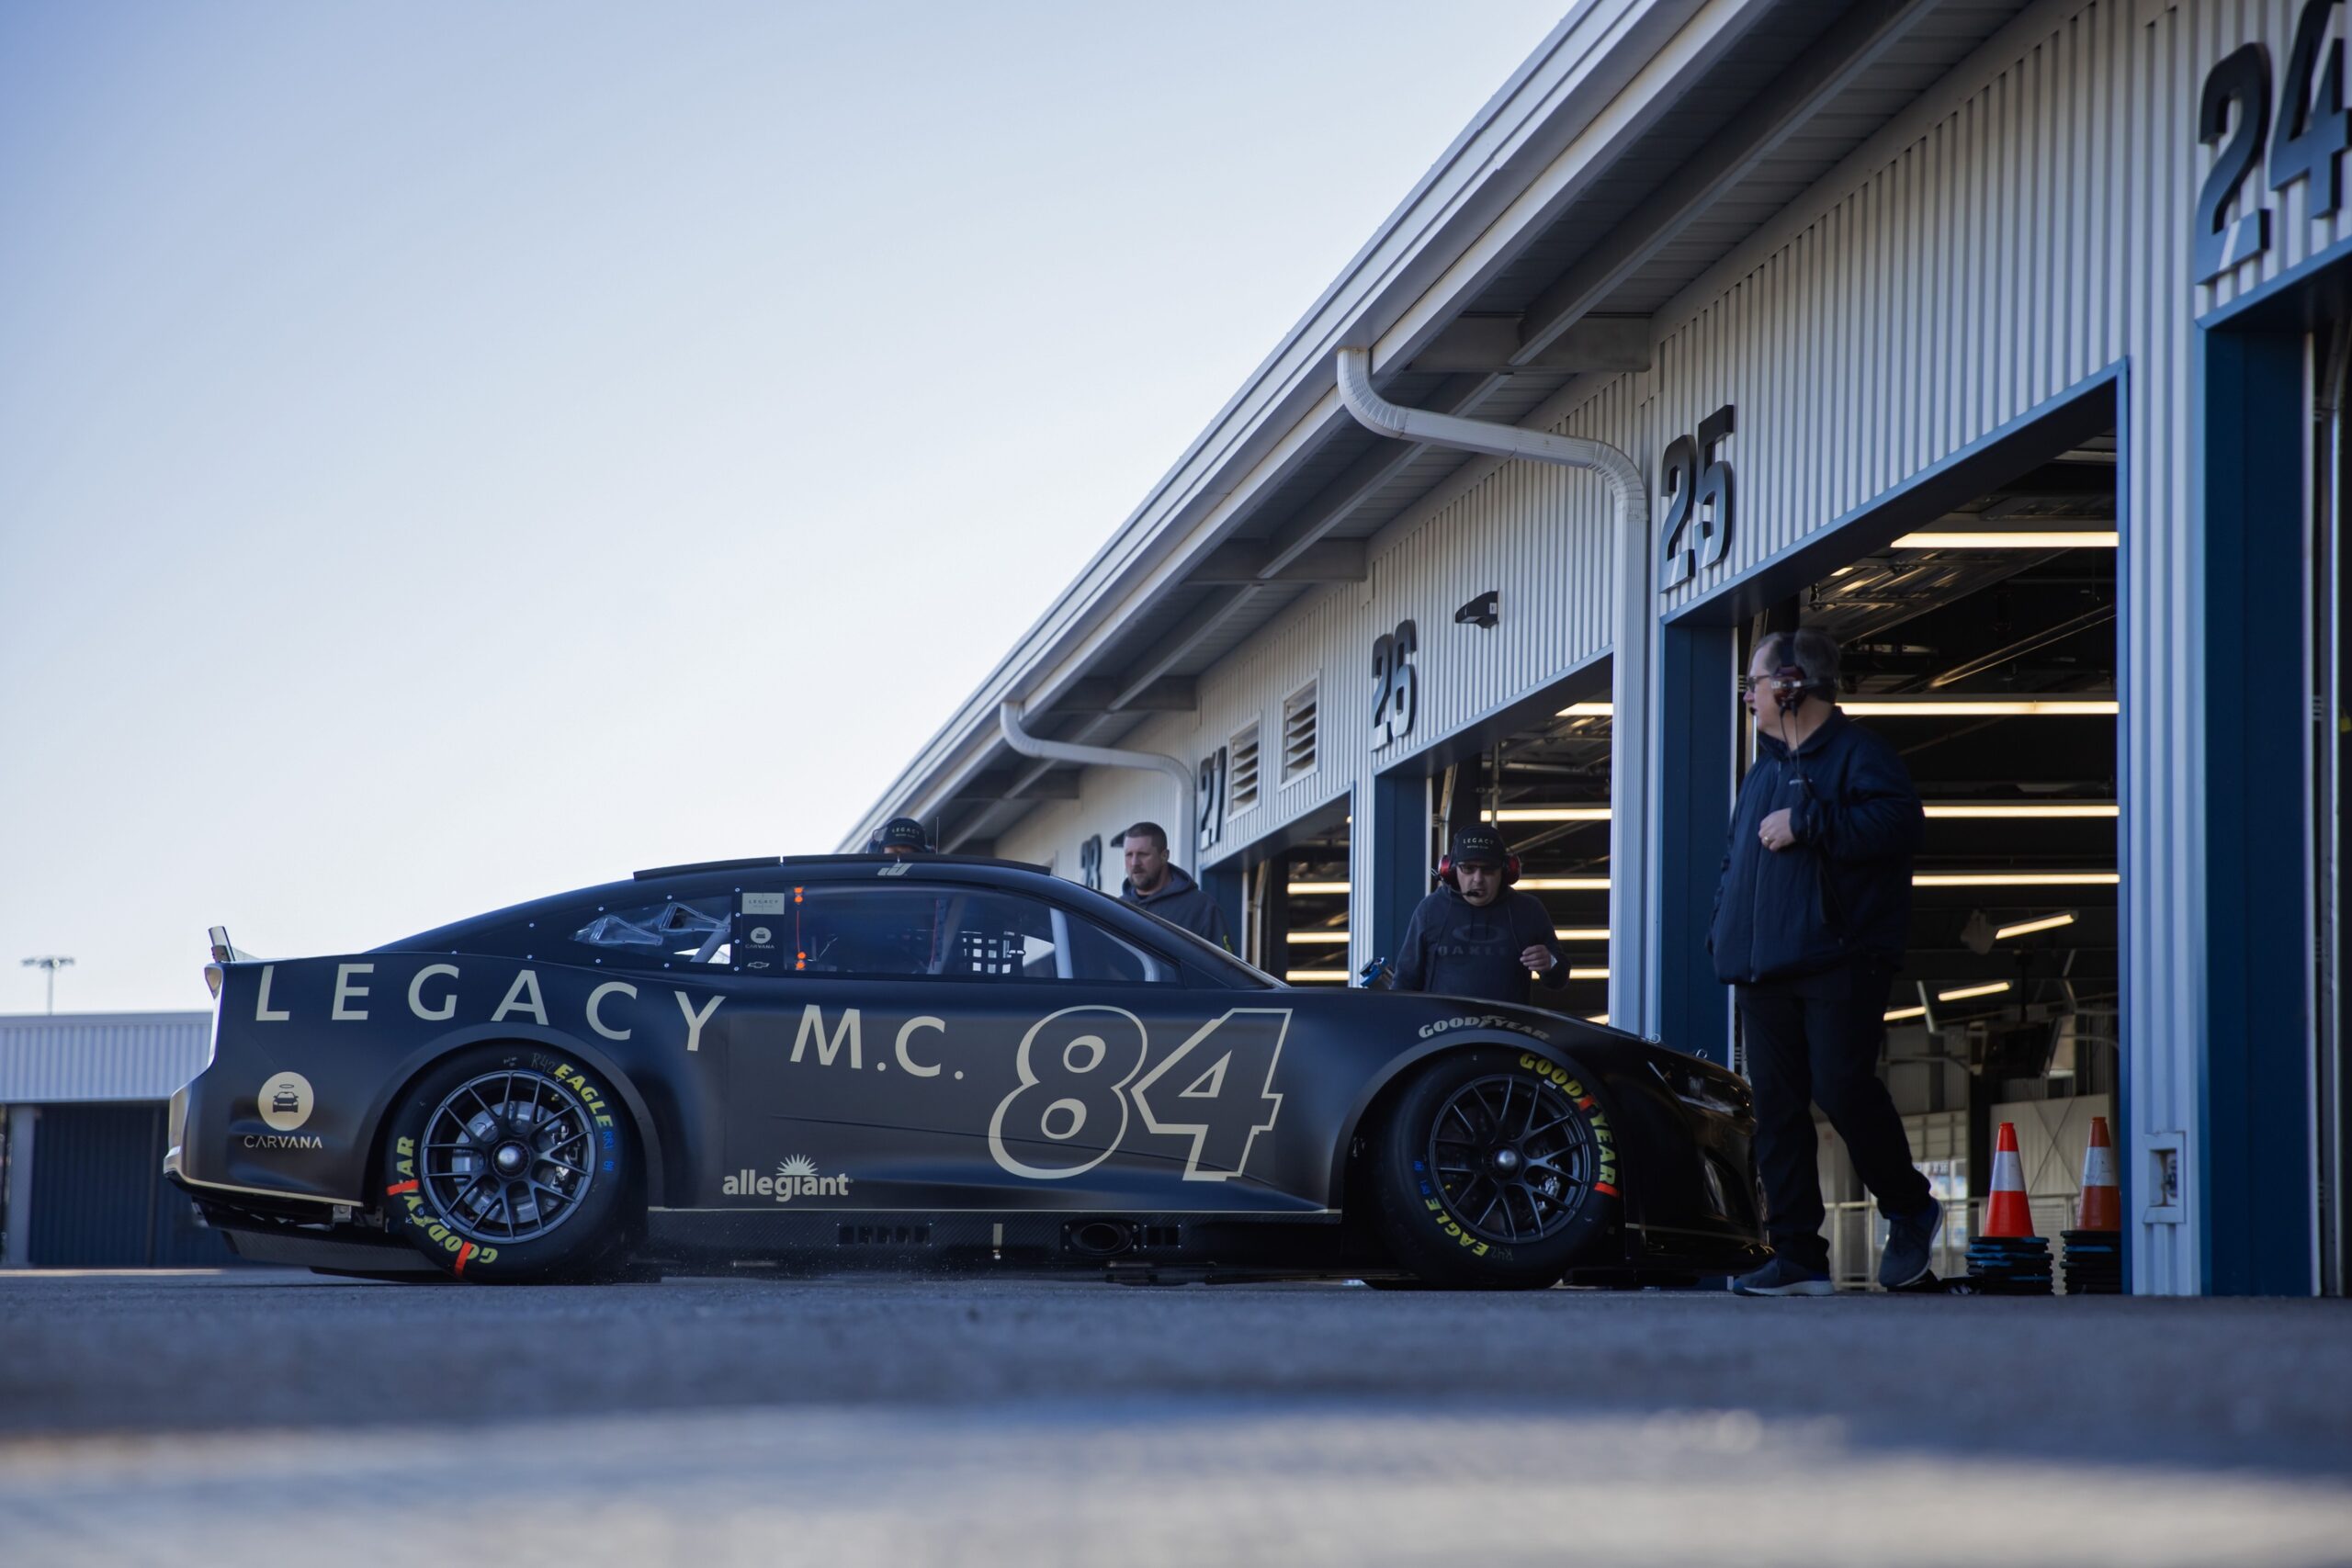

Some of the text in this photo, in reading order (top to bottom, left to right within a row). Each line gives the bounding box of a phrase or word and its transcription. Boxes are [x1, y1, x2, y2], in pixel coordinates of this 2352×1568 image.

[2195, 0, 2352, 285] 24
[1659, 404, 1734, 593] 25
[1370, 619, 1417, 752] 26
[892, 827, 920, 835] LEGACY
[1197, 745, 1227, 852] 27
[1463, 837, 1494, 845] LEGACY
[254, 963, 964, 1080] LEGACY M.C.
[1418, 1014, 1551, 1041] GOODYEAR
[553, 1063, 614, 1129] EAGLE
[988, 1005, 1294, 1181] 84
[243, 1134, 323, 1149] CARVANA
[396, 1135, 498, 1264] GOODYAR
[722, 1168, 849, 1202] allegiant
[1425, 1197, 1489, 1258] EAGLE
